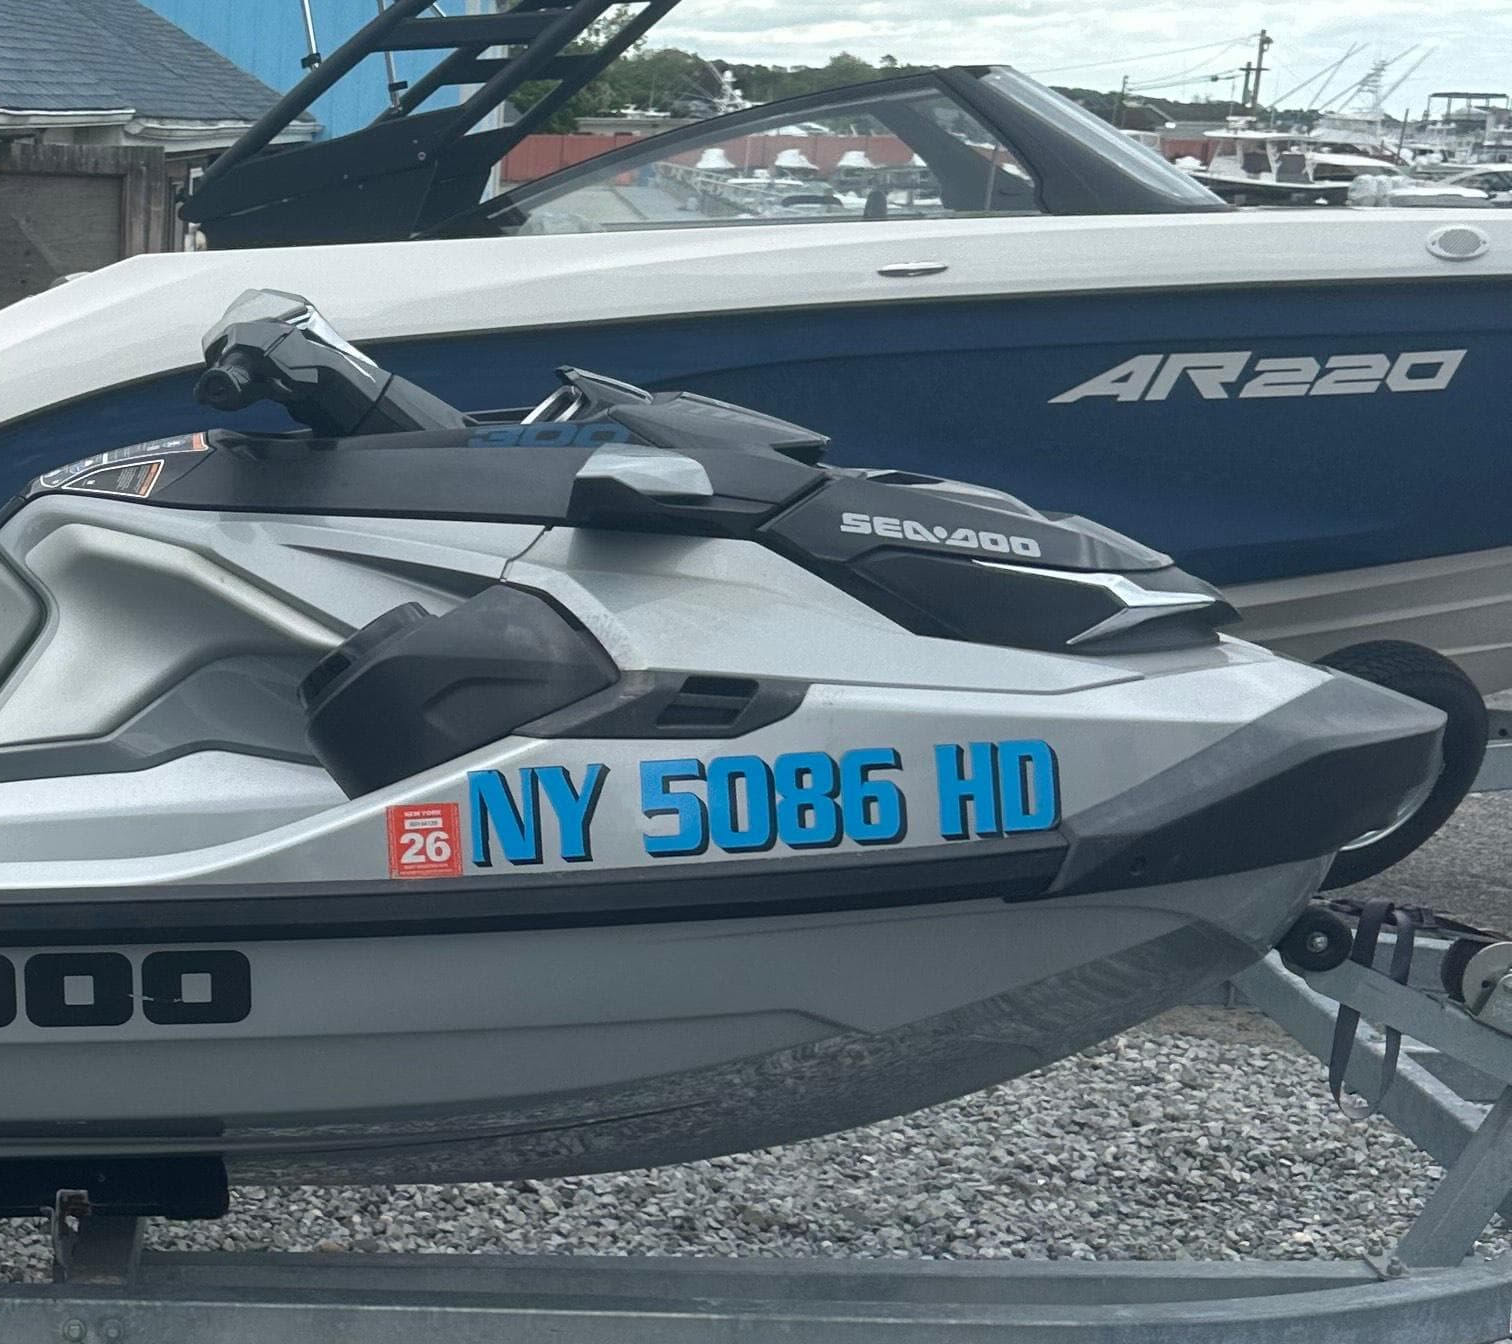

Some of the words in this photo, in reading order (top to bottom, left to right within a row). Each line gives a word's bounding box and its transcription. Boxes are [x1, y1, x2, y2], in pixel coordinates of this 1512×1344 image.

[1047, 349, 1467, 404] AR220
[468, 422, 630, 448] 300
[466, 762, 610, 868] NY
[639, 746, 908, 857] 5086
[933, 738, 1062, 842] HD
[399, 830, 451, 864] 26
